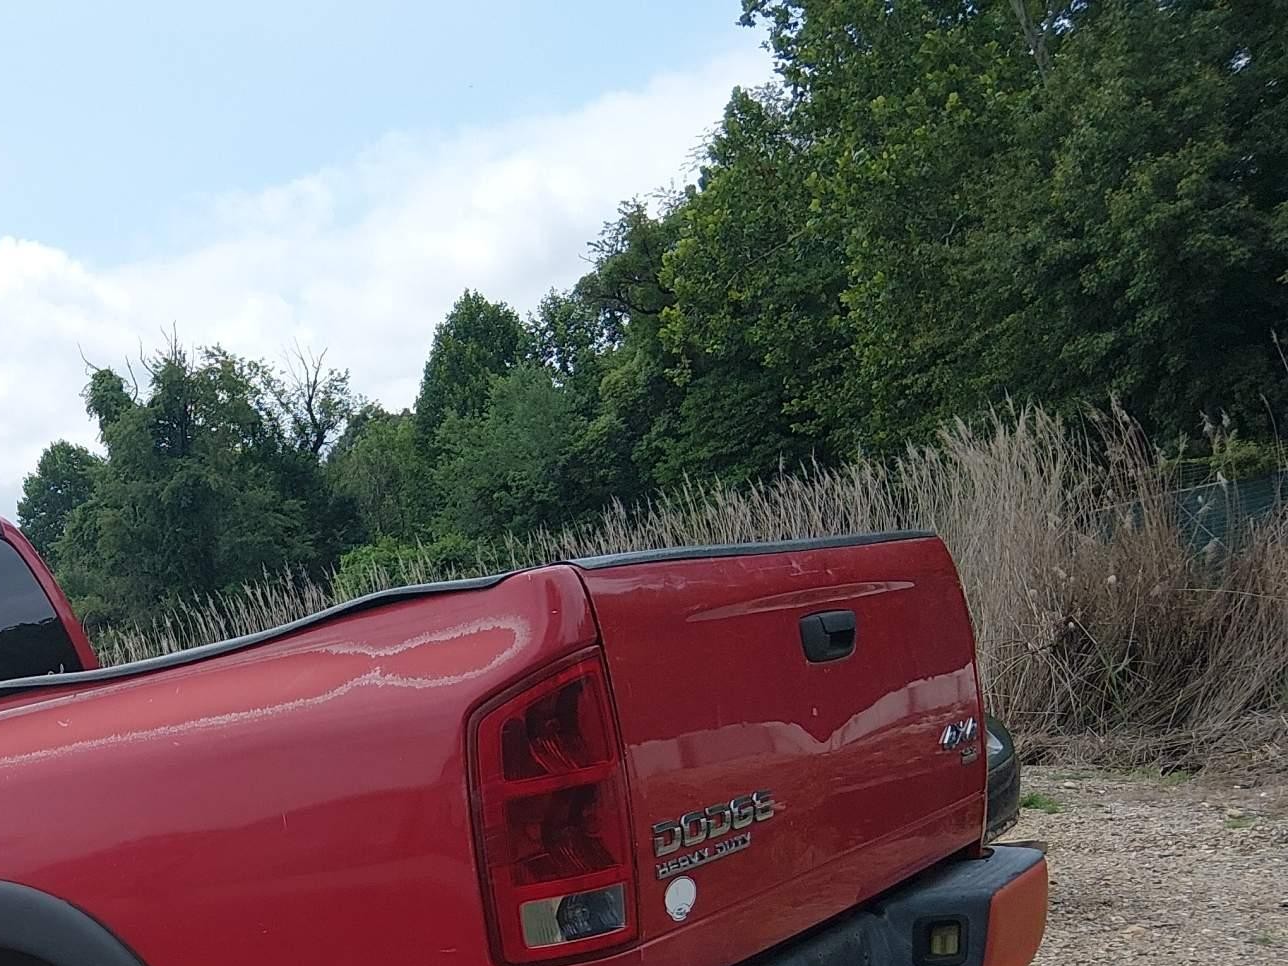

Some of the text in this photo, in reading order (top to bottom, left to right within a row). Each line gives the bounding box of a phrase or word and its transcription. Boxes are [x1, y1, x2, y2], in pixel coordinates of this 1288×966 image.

[652, 788, 775, 858] DODGE
[656, 831, 752, 879] HEAVY DUTY
